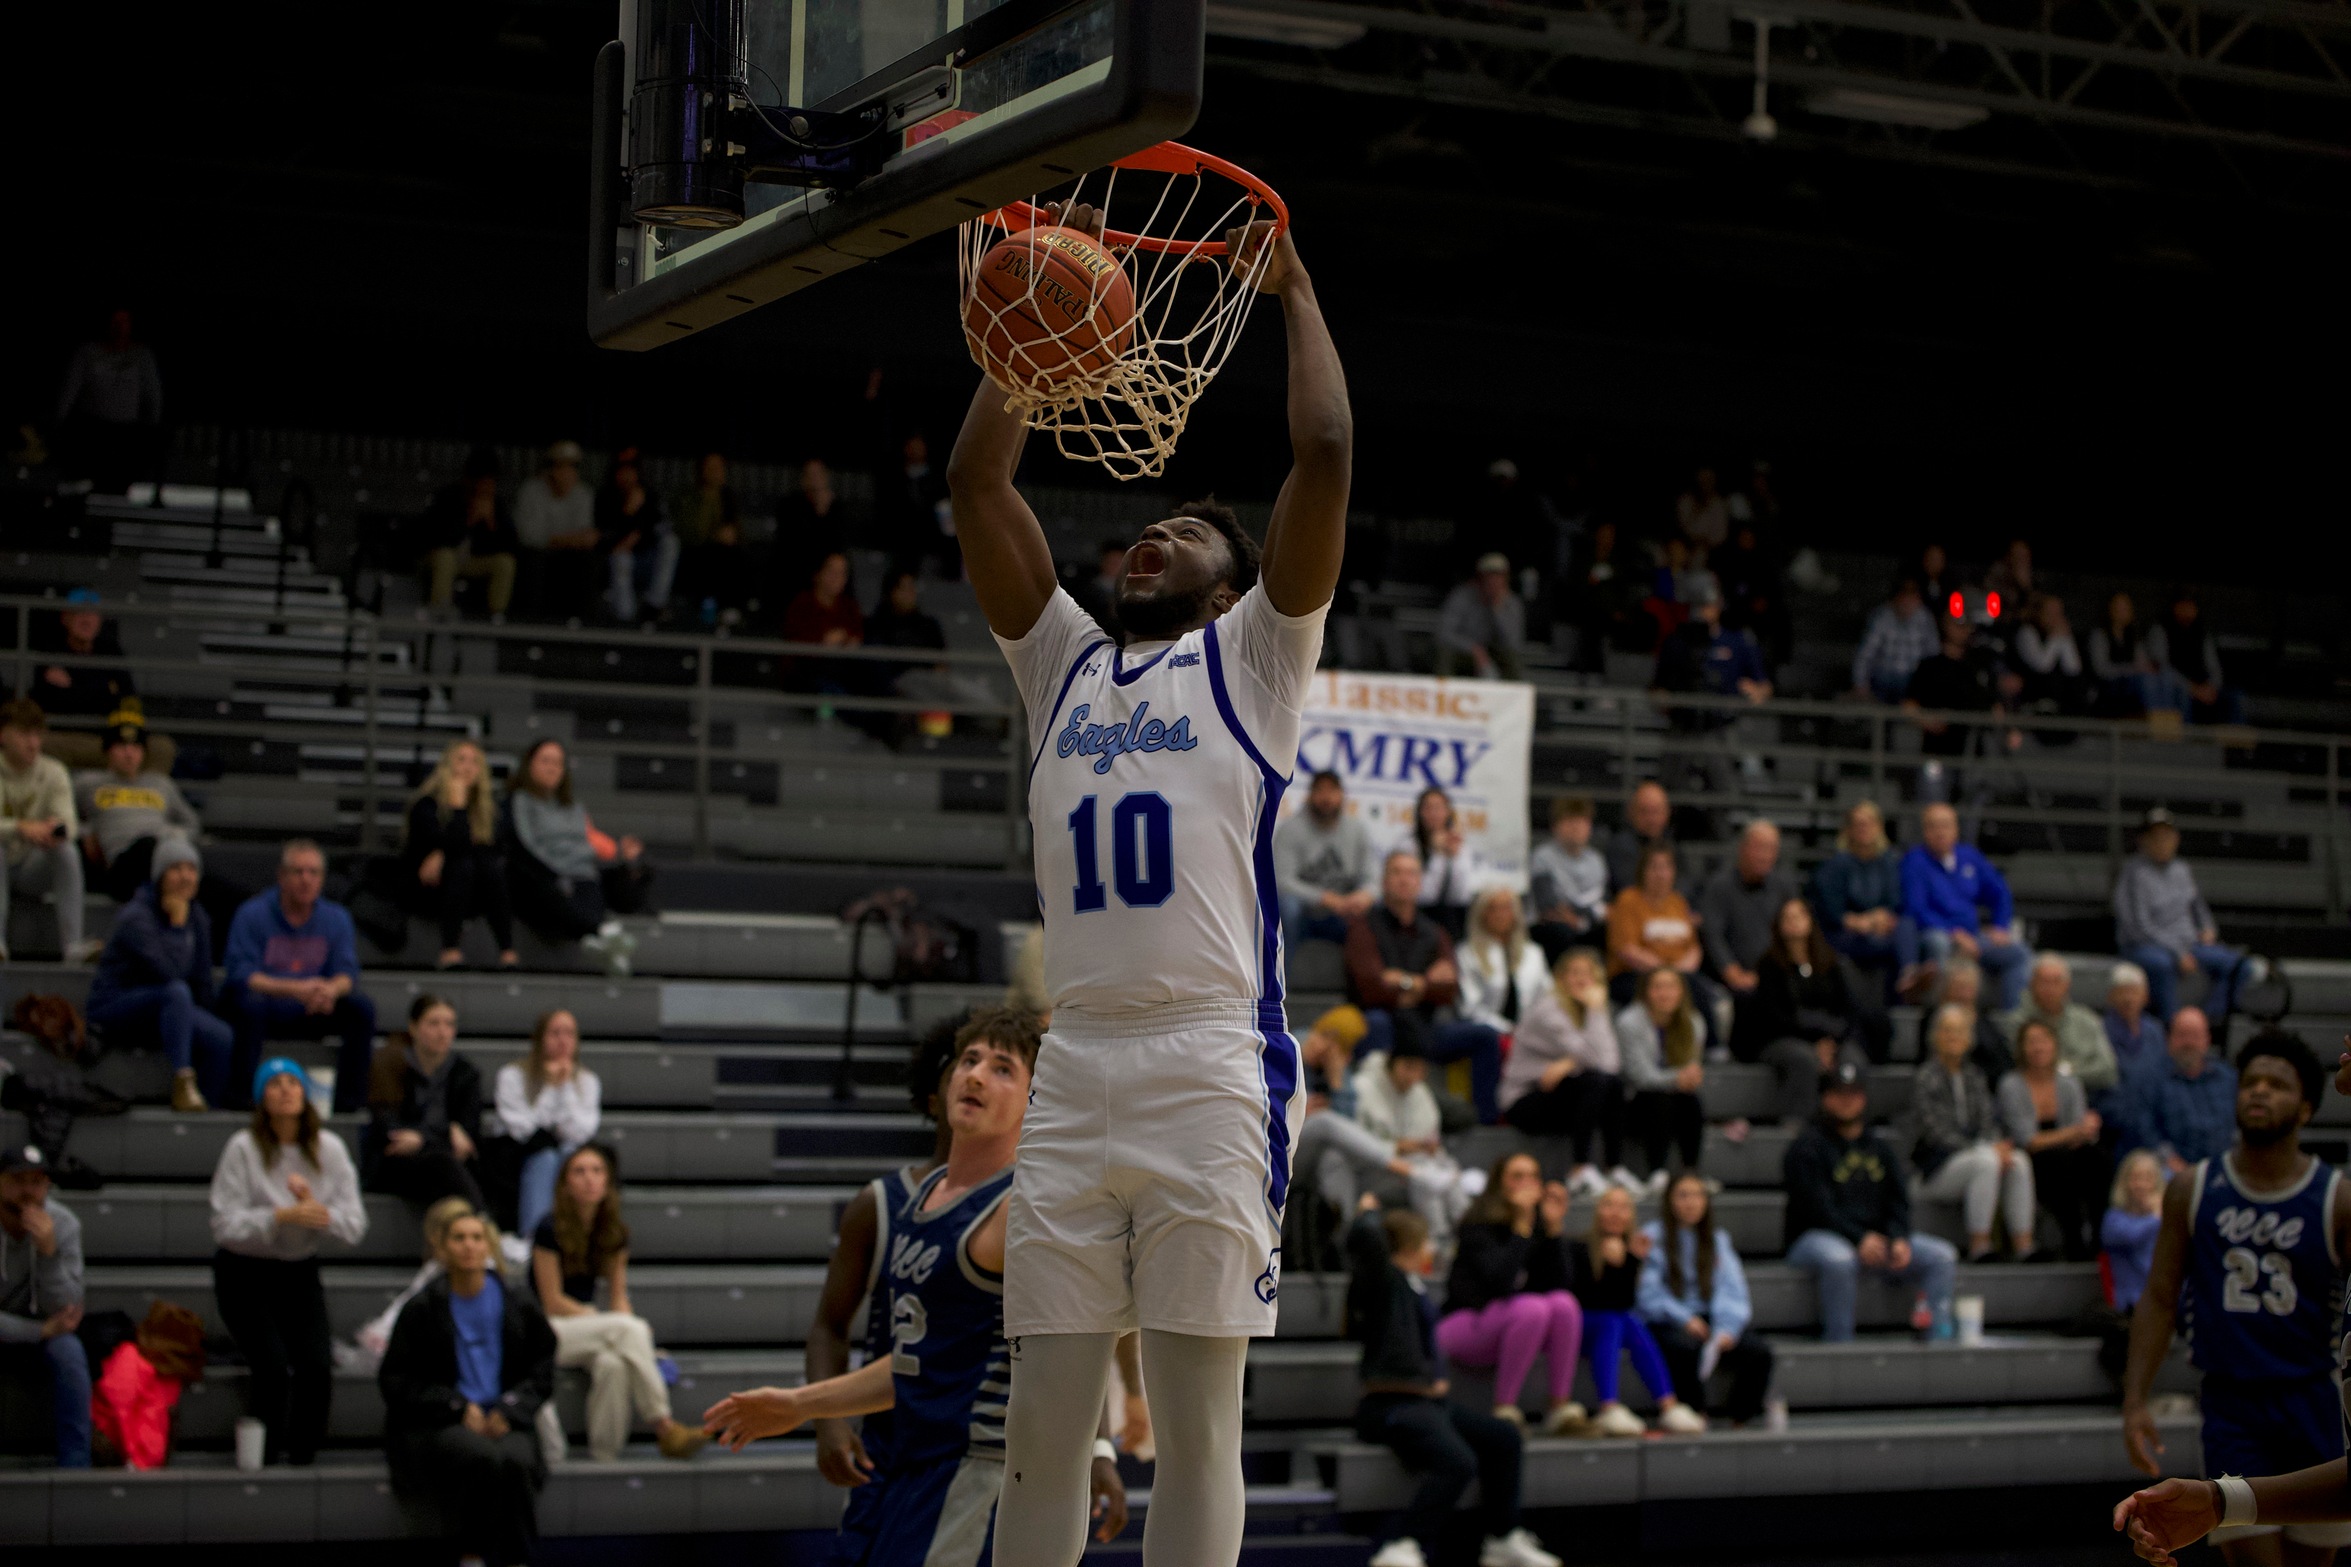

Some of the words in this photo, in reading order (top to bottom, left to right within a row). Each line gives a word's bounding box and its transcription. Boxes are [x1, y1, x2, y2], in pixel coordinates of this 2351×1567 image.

[1057, 701, 1198, 775] Eagles
[1067, 790, 1176, 915] 10
[2221, 1246, 2299, 1317] 23
